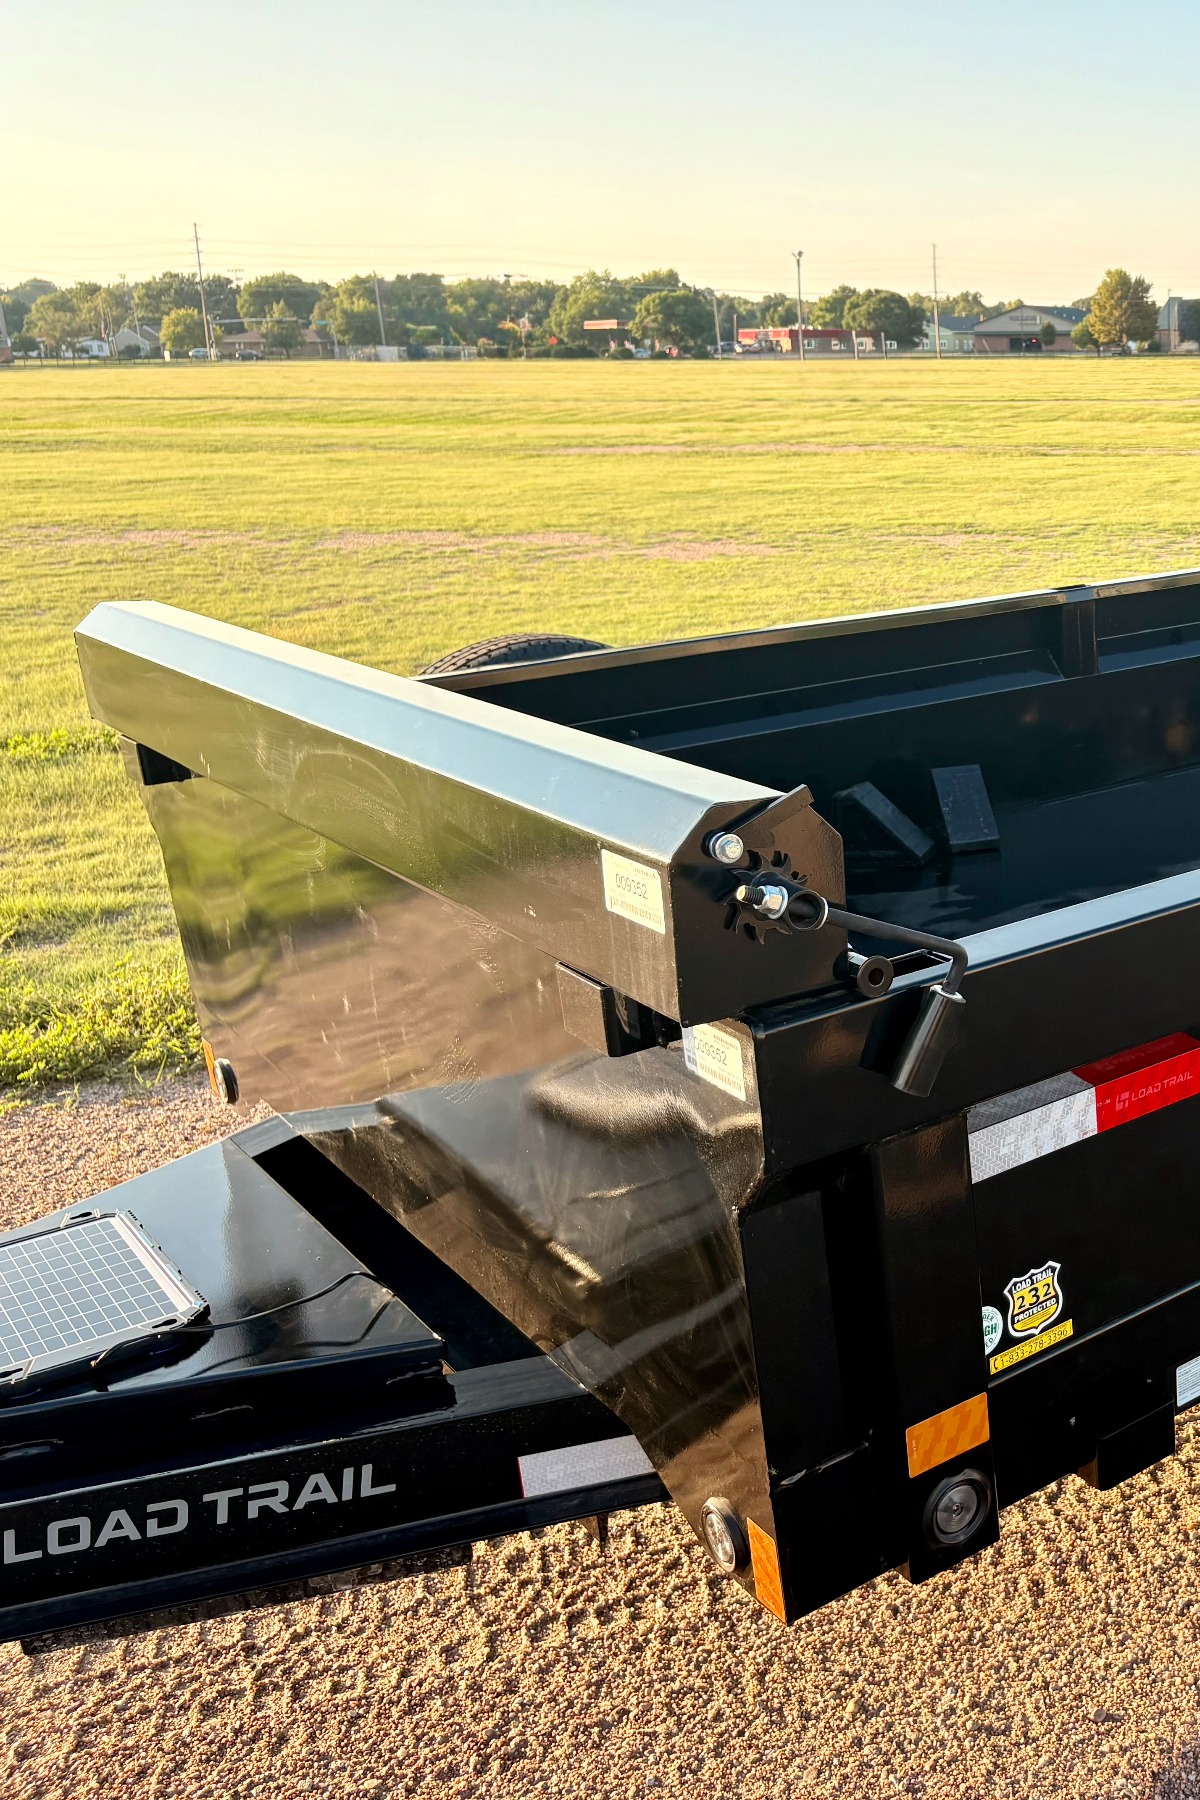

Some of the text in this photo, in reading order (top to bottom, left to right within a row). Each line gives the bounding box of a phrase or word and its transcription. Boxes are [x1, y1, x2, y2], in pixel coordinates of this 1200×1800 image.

[615, 873, 649, 900] 009352
[693, 1036, 728, 1067] 009352
[1131, 1082, 1162, 1102] LOAD
[1162, 1070, 1194, 1089] TRAIL
[1012, 1267, 1054, 1294] LOAD TRAIL
[1014, 1297, 1057, 1323] PROTECTED
[1016, 1282, 1052, 1310] 232
[1001, 1329, 1068, 1368] 1-833-278-3396
[2, 1463, 398, 1565] LOAD TRAIL
